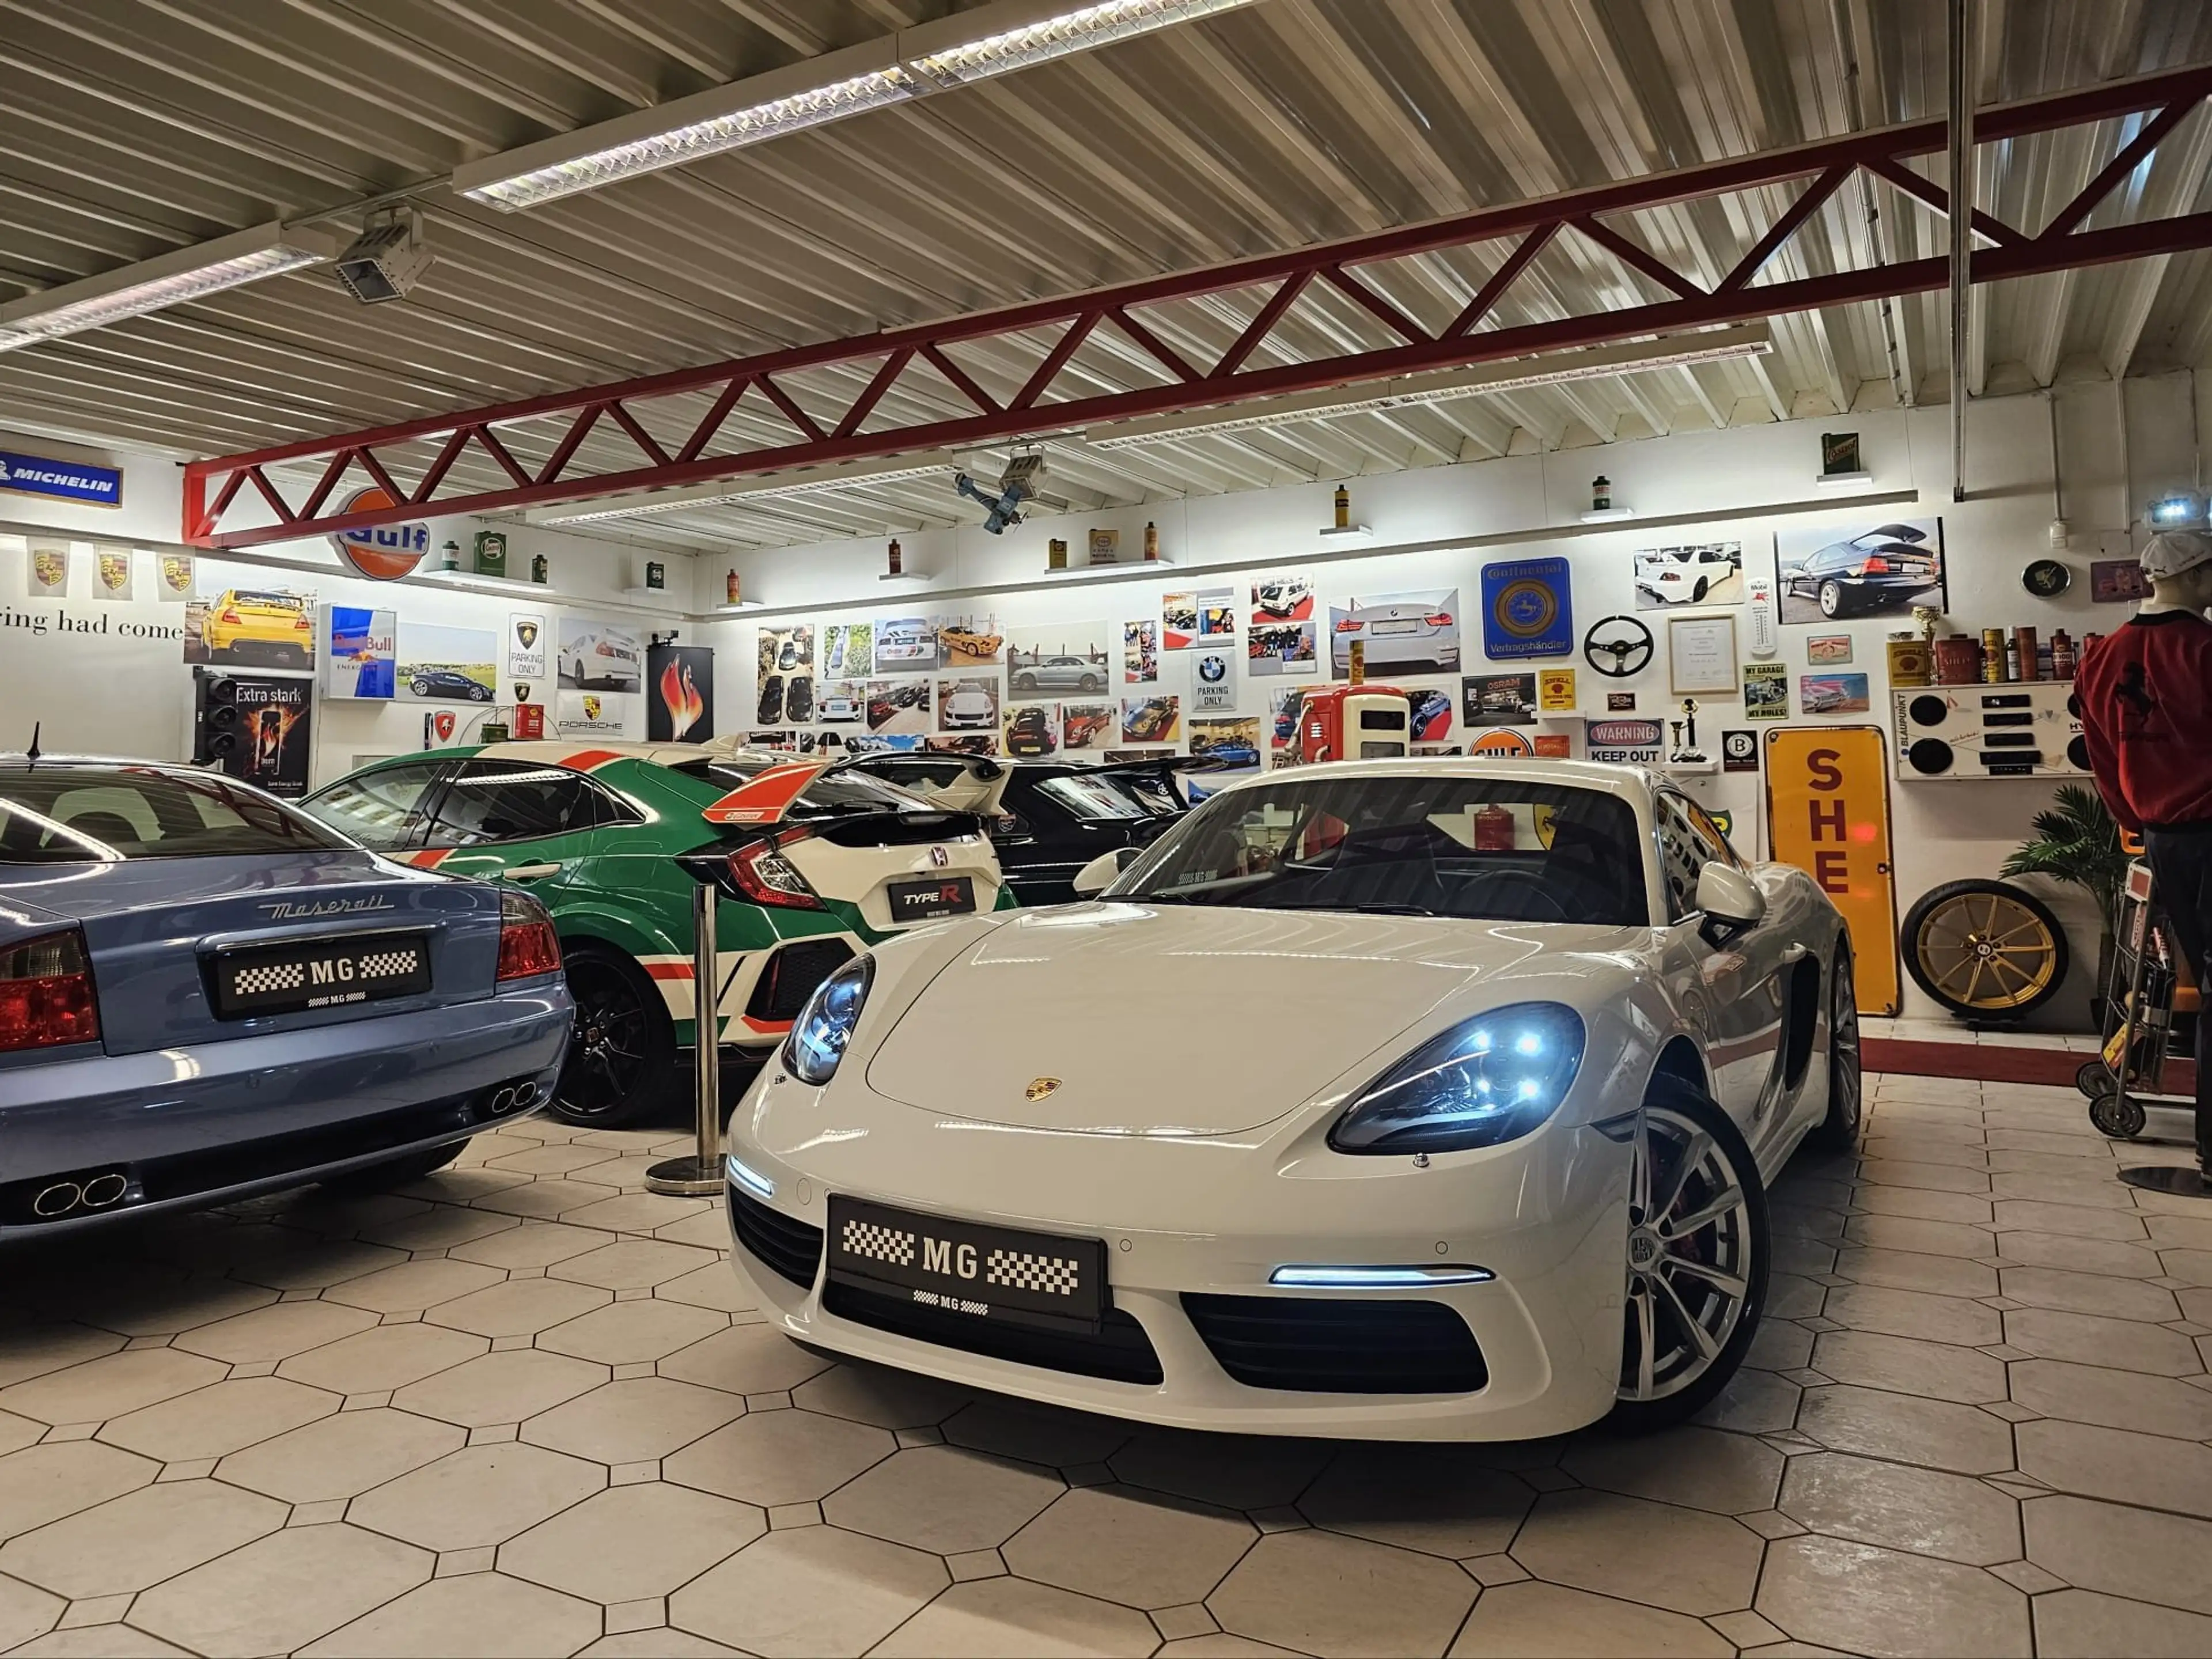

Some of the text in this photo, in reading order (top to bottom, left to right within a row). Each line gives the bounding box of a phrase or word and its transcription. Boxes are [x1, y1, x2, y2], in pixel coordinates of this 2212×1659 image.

[14, 468, 113, 492] MICHELIN
[58, 609, 108, 634] had
[119, 622, 183, 641] come
[1490, 641, 1567, 653] Vertragshändler
[511, 652, 543, 664] PARKING
[518, 664, 536, 673] ONLY
[1197, 685, 1229, 696] PARKING
[1487, 677, 1521, 690] OSRAM
[237, 687, 301, 703] Extra stark
[1204, 696, 1222, 706] ONLY
[558, 721, 623, 730] PORSCHE
[1898, 694, 1908, 747] BLAUPUNKT
[1596, 726, 1654, 740] WARNING
[1735, 738, 1746, 752] B
[1591, 751, 1659, 762] KEEP OUT
[903, 884, 963, 905] TYPE R
[257, 894, 395, 919] Maserati
[309, 958, 354, 985] MG
[330, 994, 345, 1005] MG
[922, 1236, 978, 1279] MG
[940, 1296, 959, 1310] MG
